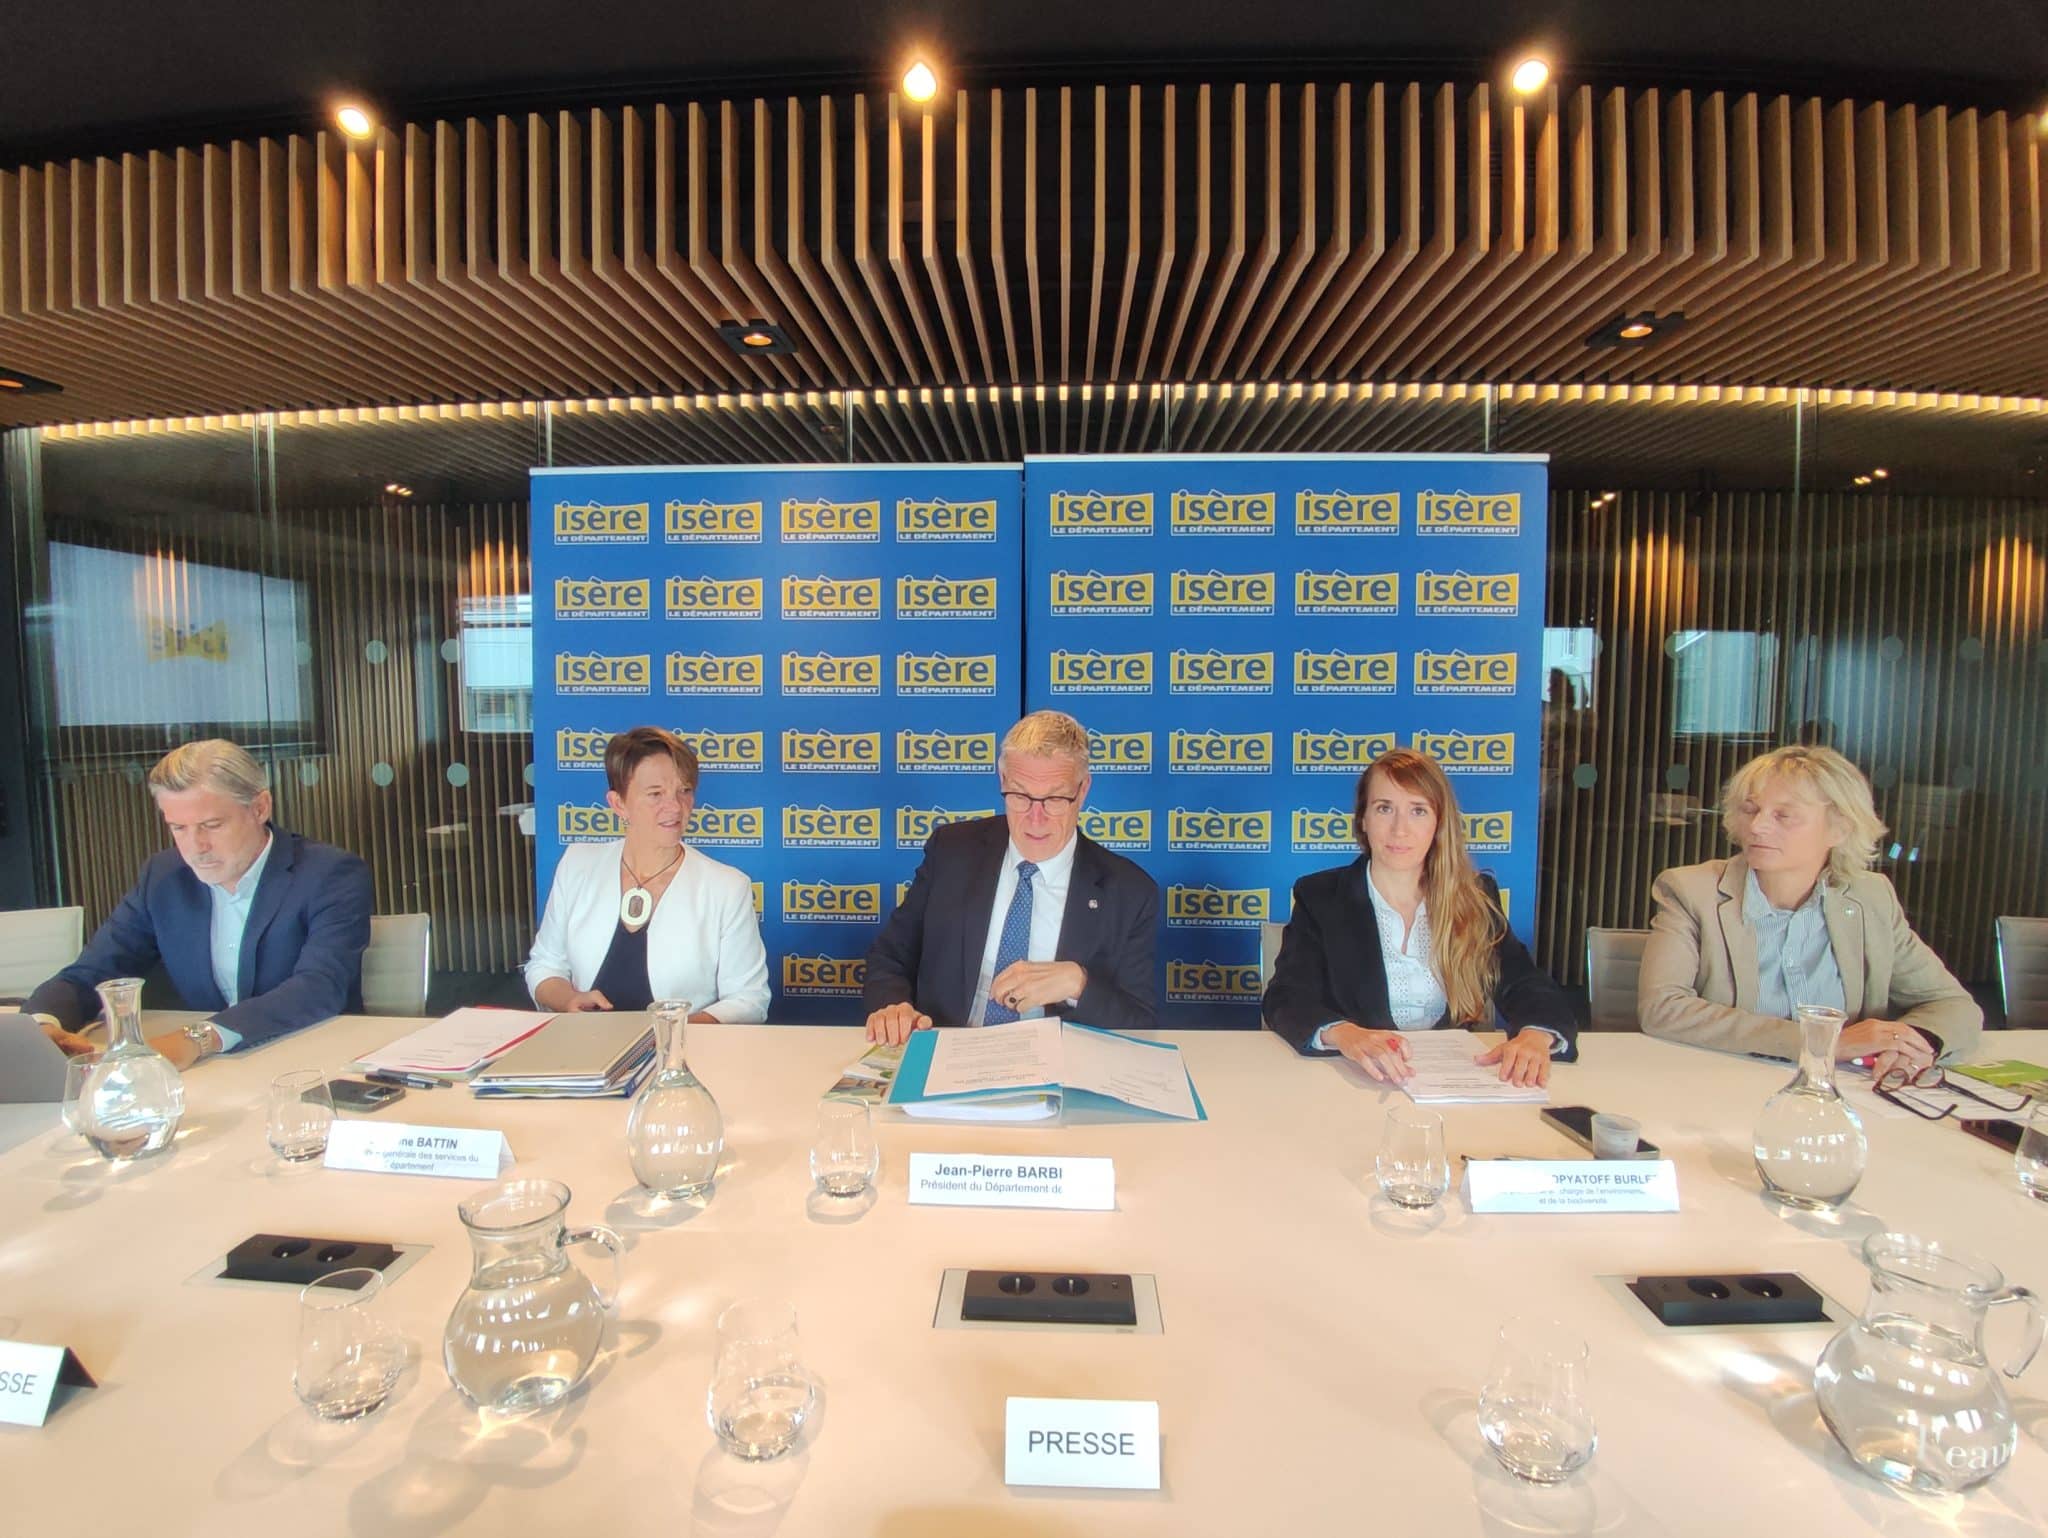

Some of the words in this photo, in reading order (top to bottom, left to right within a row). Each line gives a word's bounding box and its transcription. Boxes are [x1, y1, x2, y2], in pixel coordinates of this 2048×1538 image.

[561, 501, 642, 532] isère
[672, 500, 755, 530] isère
[788, 499, 872, 530] isère
[903, 498, 989, 529] isère
[1057, 491, 1146, 523] isère
[1178, 490, 1267, 522] isère
[1303, 490, 1392, 522] isère
[1424, 491, 1513, 522] isère
[571, 534, 645, 542] DÉPARTEMENT
[682, 533, 758, 541] DÉPARTEMENT
[1068, 525, 1150, 534] DÉPARTEMENT
[1189, 525, 1271, 533] DÉPARTEMENT
[562, 577, 642, 607] isère
[672, 576, 755, 607] isère
[788, 576, 873, 606] isère
[904, 576, 989, 606] isère
[1058, 571, 1146, 602] isère
[1178, 570, 1267, 602] isère
[1302, 570, 1391, 602] isère
[1423, 571, 1512, 602] isère
[1069, 605, 1150, 613] DÉPARTEMENT
[562, 652, 643, 682] isère
[673, 652, 755, 682] isère
[789, 653, 873, 682] isère
[904, 653, 988, 683] isère
[1057, 650, 1145, 681] isère
[1177, 650, 1266, 681] isère
[1301, 650, 1389, 681] isère
[1421, 650, 1510, 681] isère
[564, 730, 608, 757] isè
[676, 728, 755, 758] sère
[789, 730, 873, 759] isère
[904, 730, 988, 760] isère
[1088, 730, 1144, 760] ère
[1176, 730, 1265, 760] isère
[565, 804, 619, 832] isèr
[686, 805, 756, 834] sère
[789, 806, 873, 835] isère
[1079, 808, 1143, 837] ère
[1175, 808, 1264, 839] isère
[1299, 809, 1356, 839] isè
[789, 880, 873, 910] isère
[1174, 884, 1262, 914] isère
[1174, 961, 1260, 990] isère
[417, 1138, 458, 1149] BATTIN
[920, 1179, 966, 1190] Président
[969, 1182, 982, 1192] du
[985, 1182, 1048, 1193] Département
[935, 1164, 1012, 1178] Jean-Pierre
[1028, 1430, 1135, 1456] PRESSE
